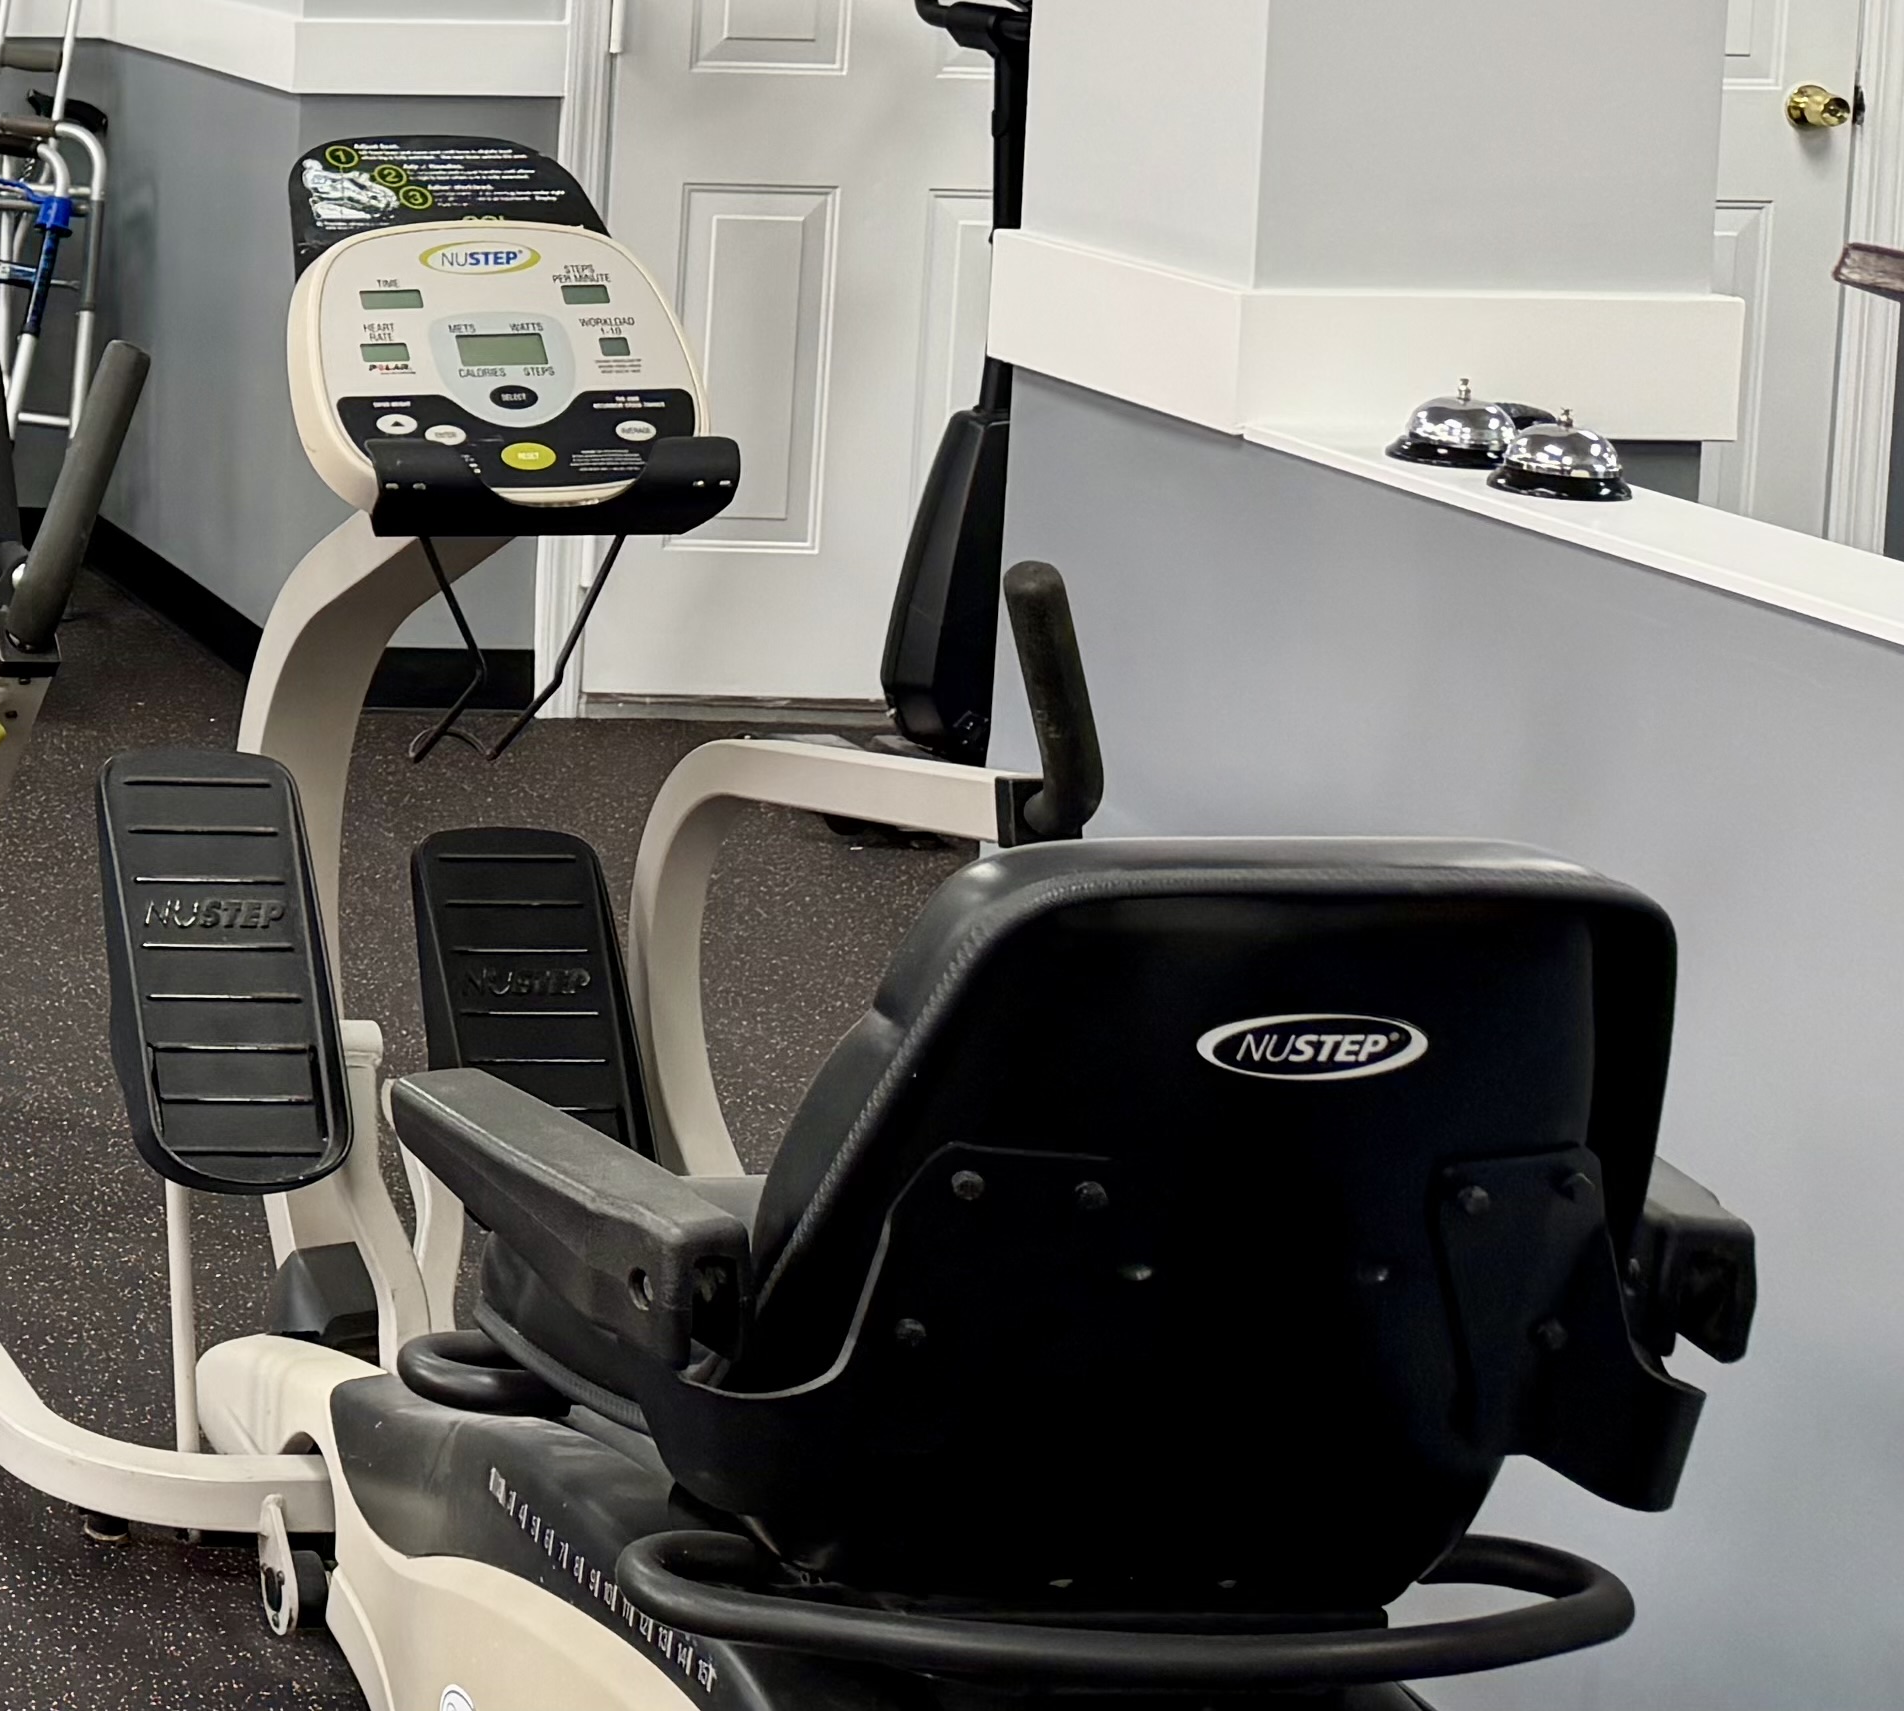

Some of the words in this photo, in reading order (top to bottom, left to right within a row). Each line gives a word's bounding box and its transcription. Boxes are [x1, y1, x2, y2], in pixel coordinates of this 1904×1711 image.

[335, 149, 347, 163] 1
[383, 169, 399, 181] 2
[409, 191, 422, 204] 3
[441, 251, 519, 266] NUSTEP
[363, 323, 394, 332] HEART
[578, 317, 635, 327] WORKLOAD
[458, 368, 507, 378] CALORIES
[523, 367, 555, 377] STEPS
[143, 899, 285, 929] NUSTEP
[1236, 1033, 1390, 1063] NUSTEP
